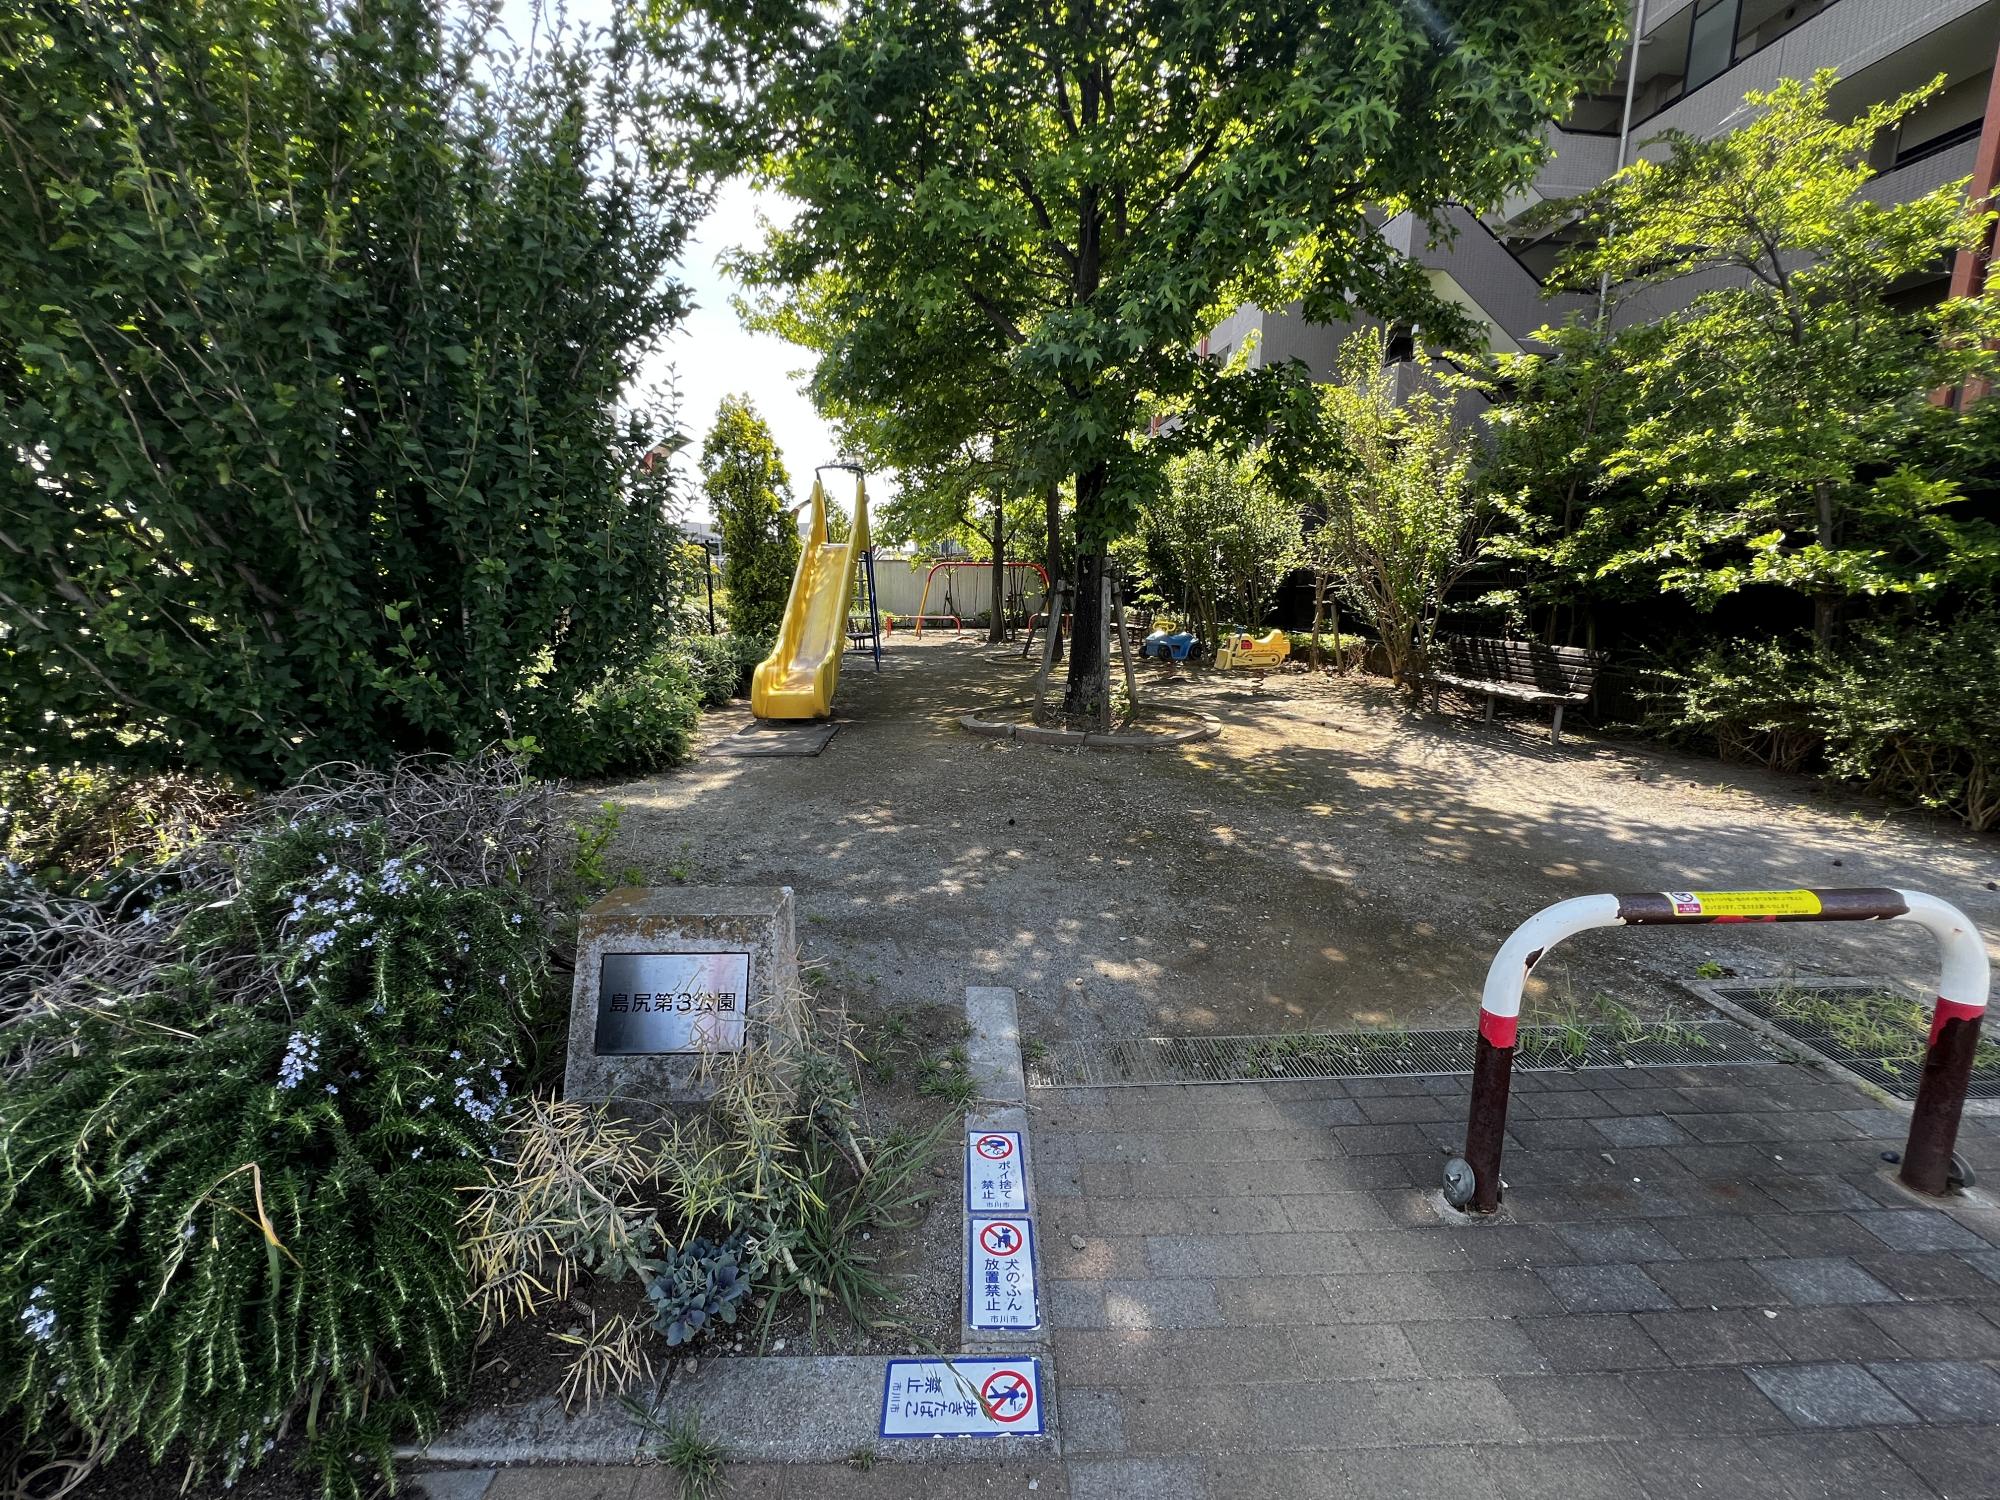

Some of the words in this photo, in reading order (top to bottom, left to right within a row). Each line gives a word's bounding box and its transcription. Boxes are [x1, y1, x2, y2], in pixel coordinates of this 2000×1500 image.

[981, 1180, 995, 1200] 禁止
[998, 1161, 1012, 1199] ポイ捨て
[984, 1258, 1001, 1311] 放置禁止
[1005, 1258, 1022, 1311] 犬のふん
[990, 1315, 1019, 1323] 市川市
[890, 1382, 901, 1413] 市川市
[907, 1377, 942, 1394] 禁止
[905, 1400, 978, 1418] 歩きたばこ
